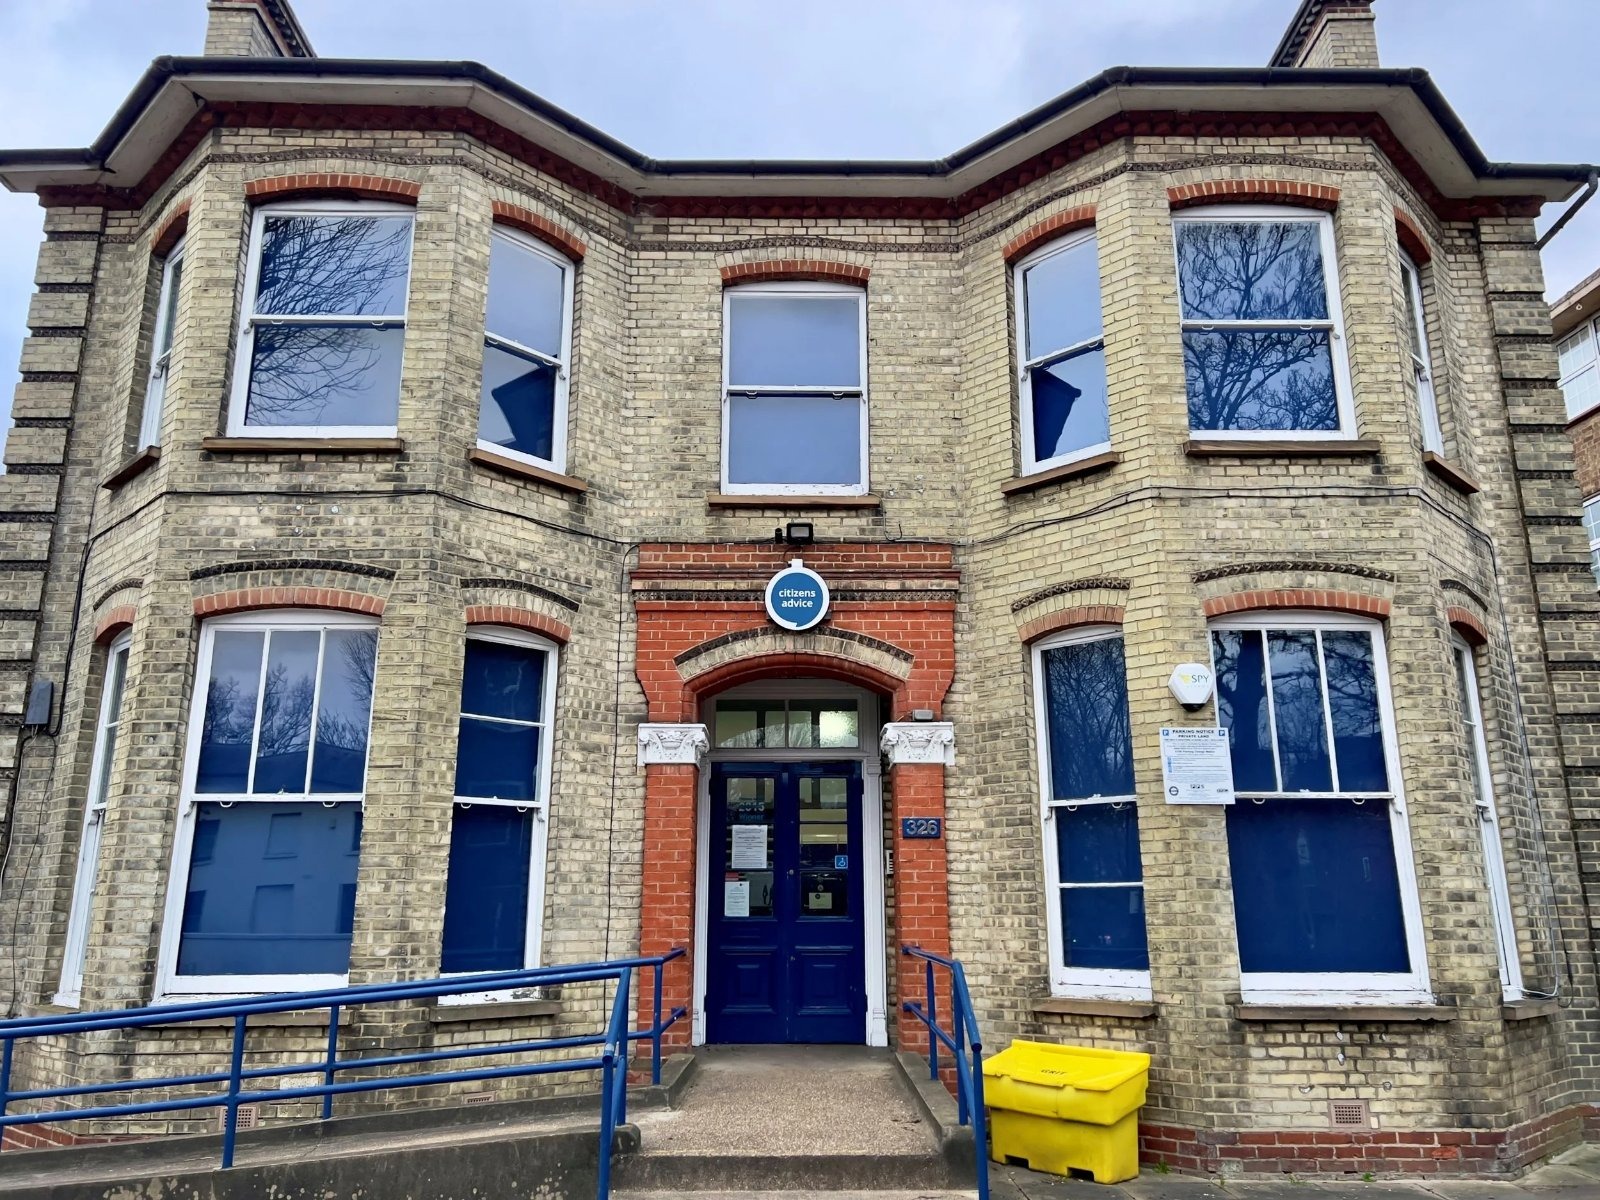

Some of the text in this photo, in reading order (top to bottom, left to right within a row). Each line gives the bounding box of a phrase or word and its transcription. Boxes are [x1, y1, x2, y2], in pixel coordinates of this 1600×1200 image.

[778, 588, 816, 597] citizens
[781, 598, 813, 607] advice
[1191, 674, 1210, 683] SPY
[906, 819, 938, 835] 326
